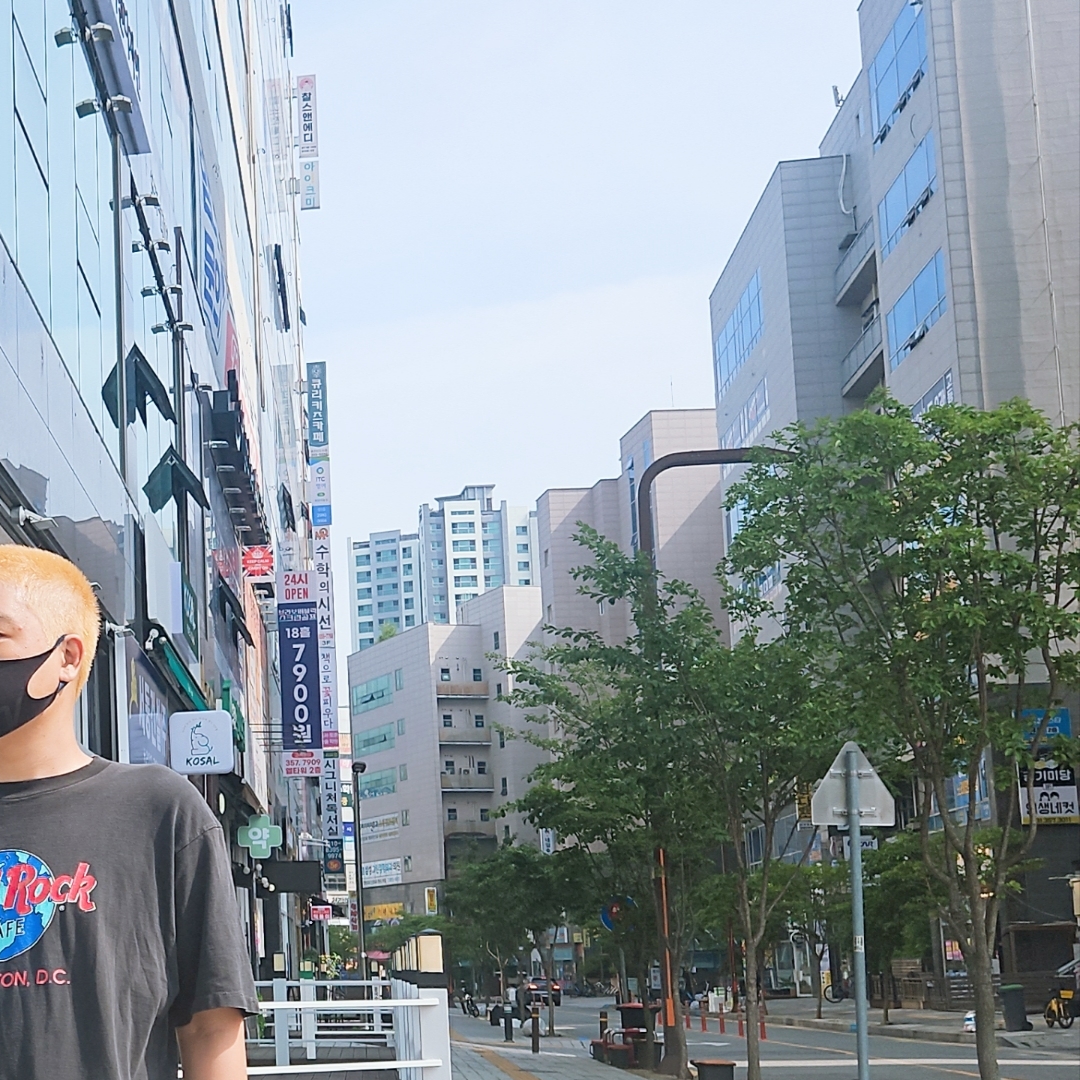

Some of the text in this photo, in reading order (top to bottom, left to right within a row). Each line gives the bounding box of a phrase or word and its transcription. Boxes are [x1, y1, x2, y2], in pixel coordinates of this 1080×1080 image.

[284, 573, 308, 585] 24시
[285, 587, 308, 600] OPEN
[315, 545, 331, 630] 수학의시선
[285, 626, 311, 638] 18홀
[185, 756, 220, 767] KOSAL
[324, 759, 339, 837] 시그니처독서실
[248, 827, 270, 850] 약
[4, 862, 98, 916] Rock
[36, 969, 70, 985] D.C.
